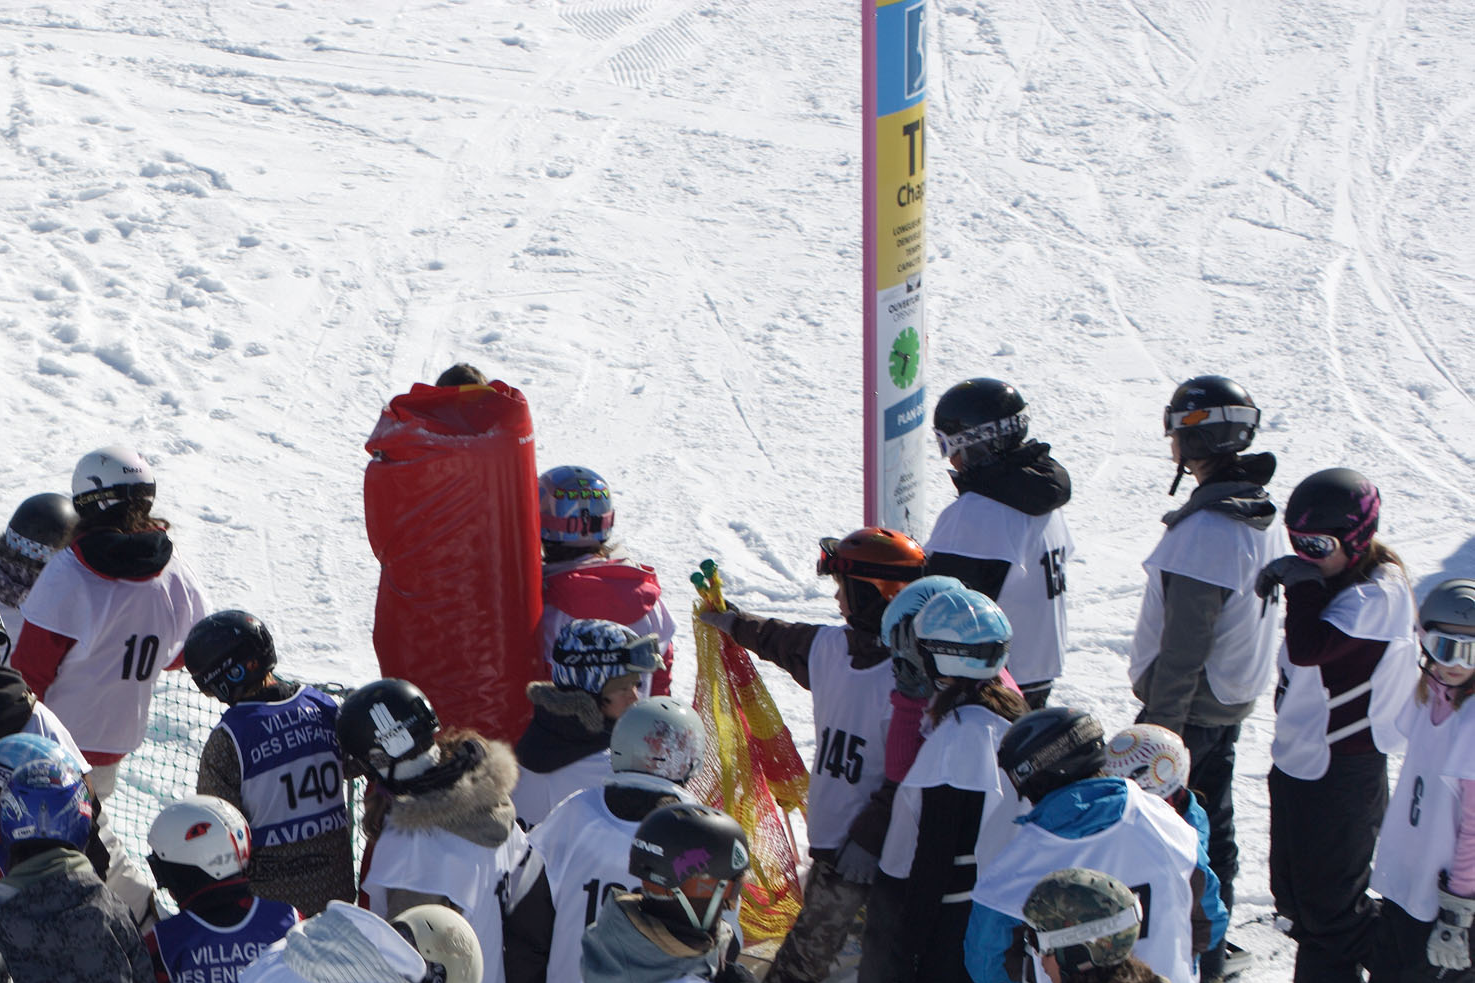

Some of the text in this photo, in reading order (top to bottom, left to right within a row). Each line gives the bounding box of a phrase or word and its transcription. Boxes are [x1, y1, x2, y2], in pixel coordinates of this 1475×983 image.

[121, 634, 160, 682] 10
[250, 737, 283, 764] DES
[816, 727, 866, 785] 145
[279, 760, 340, 811] 140
